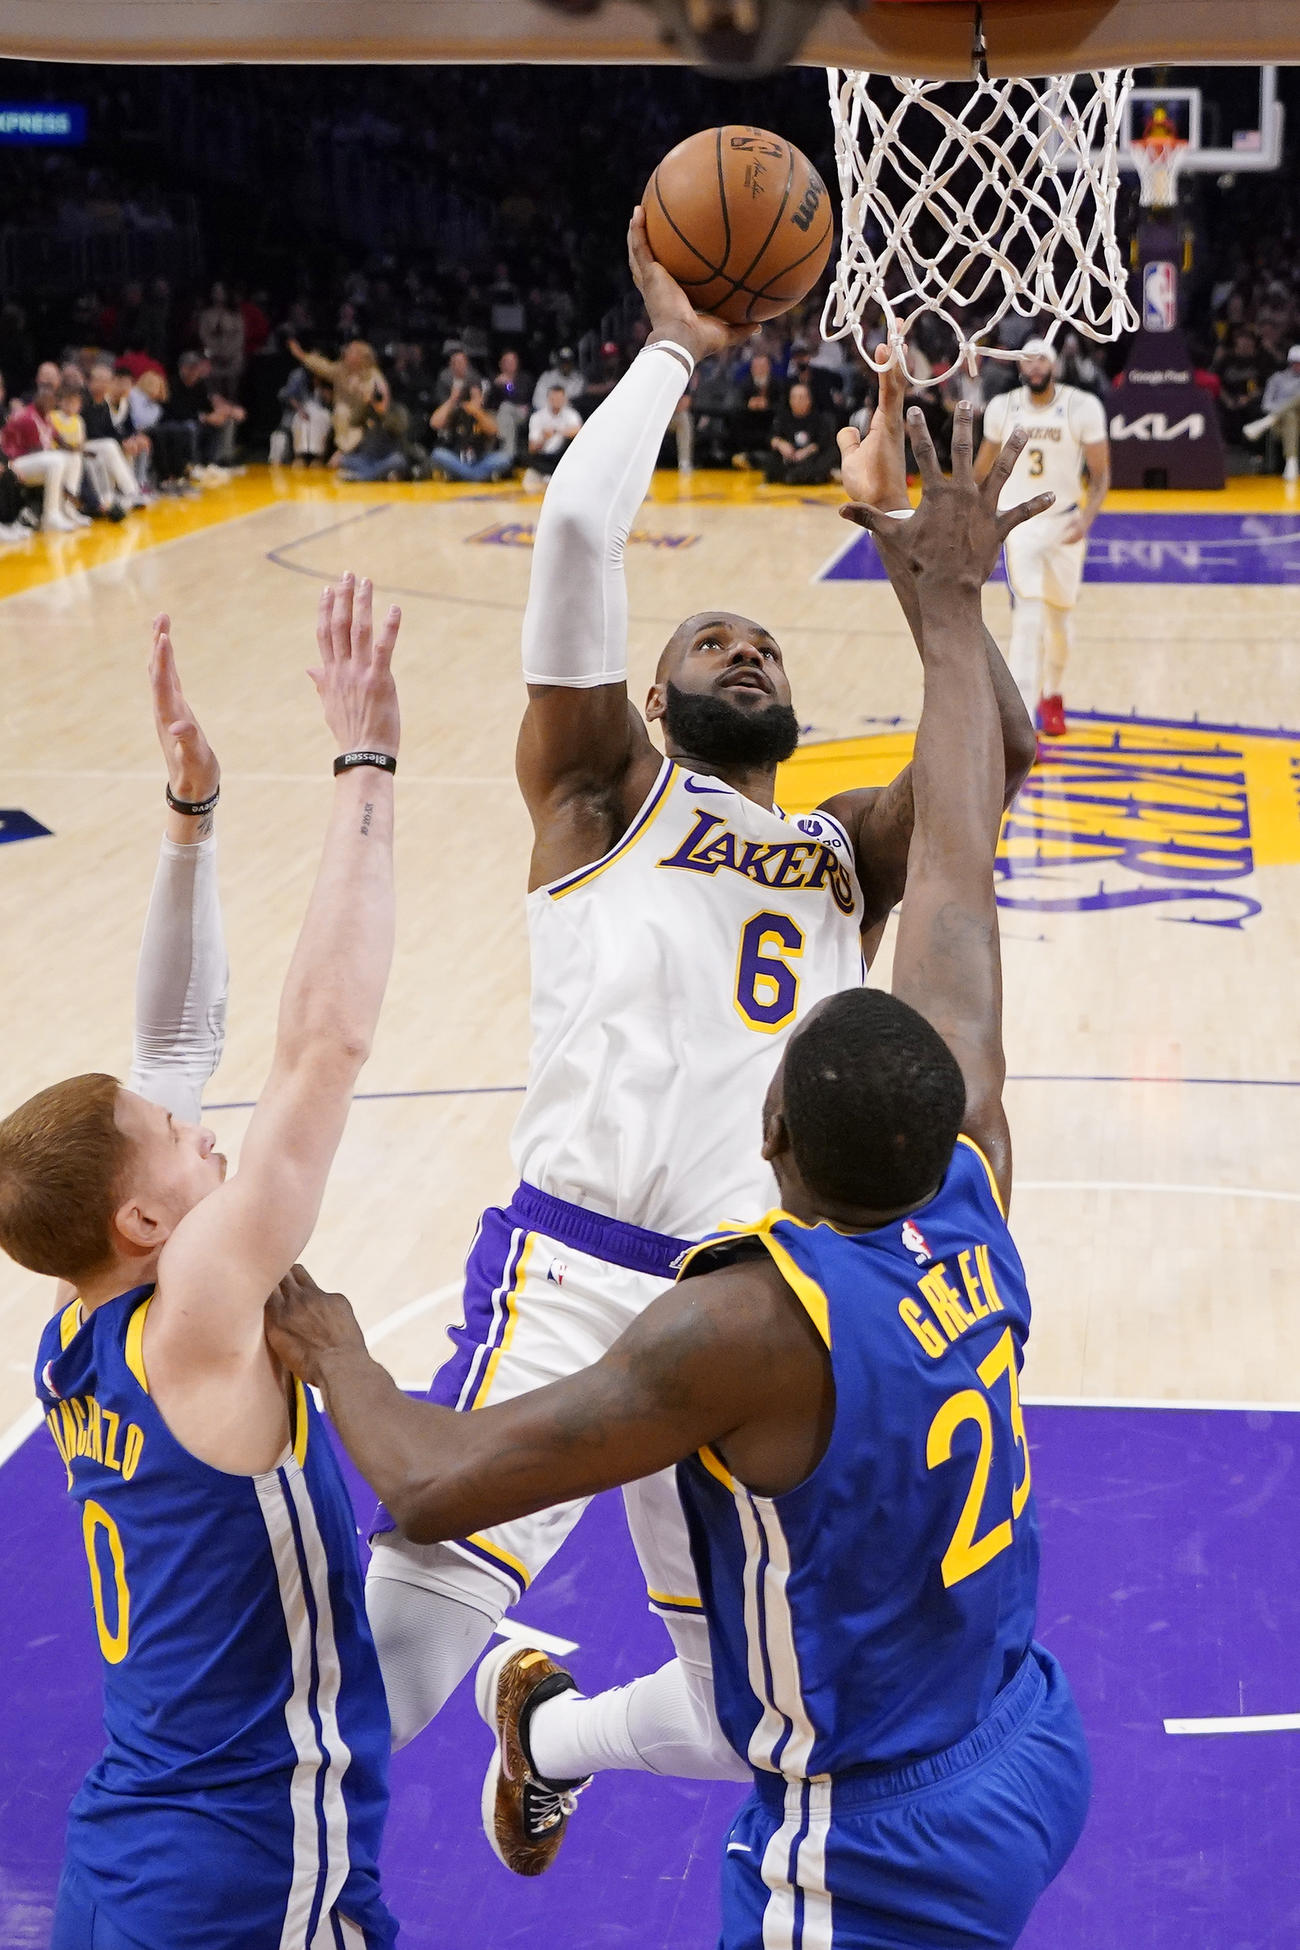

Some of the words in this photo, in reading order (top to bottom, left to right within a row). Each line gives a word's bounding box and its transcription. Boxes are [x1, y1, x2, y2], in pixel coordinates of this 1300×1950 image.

[1028, 448, 1044, 479] 3
[1110, 413, 1205, 441] KIA
[344, 752, 387, 766] Blessed
[655, 808, 856, 917] LAKERS
[733, 909, 806, 1035] 6
[898, 1244, 1005, 1358] GREEN
[83, 1499, 130, 1665] 0
